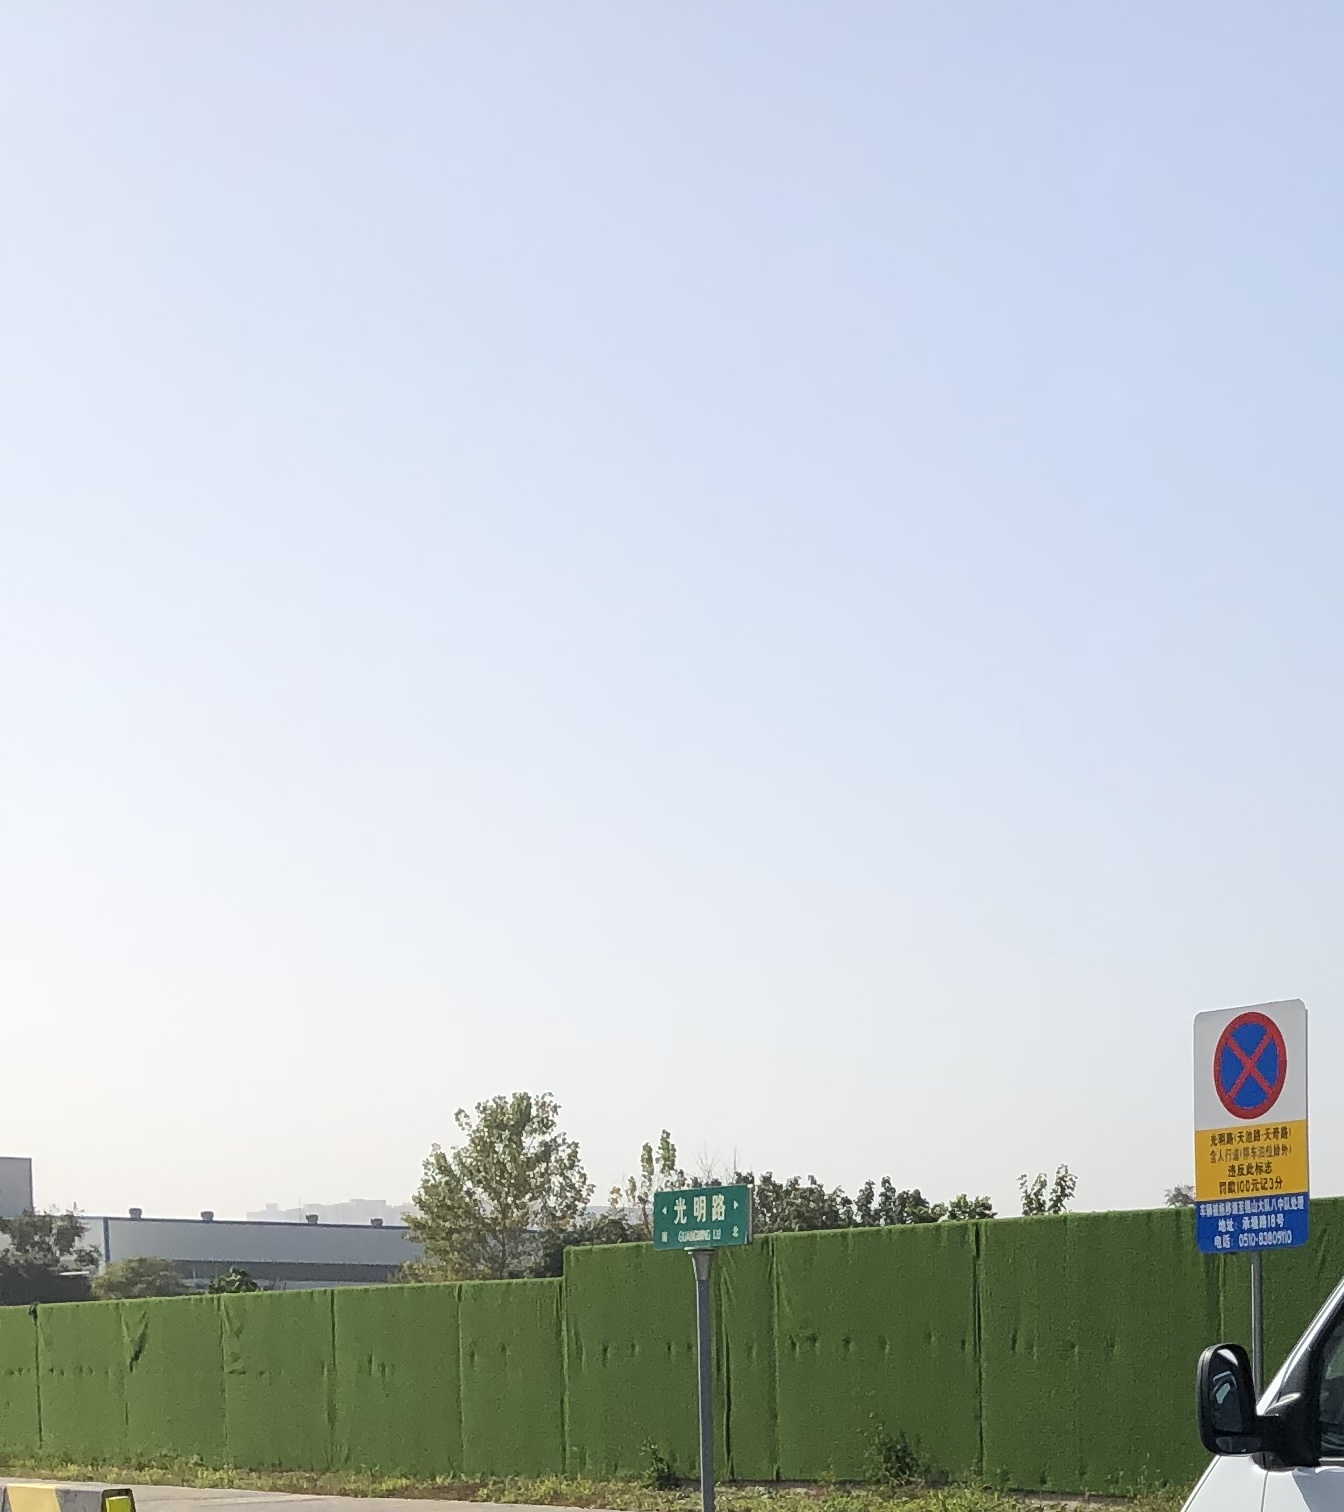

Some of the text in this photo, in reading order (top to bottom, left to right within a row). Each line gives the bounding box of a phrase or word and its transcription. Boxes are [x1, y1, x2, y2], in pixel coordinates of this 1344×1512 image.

[1228, 1160, 1273, 1178] 违反此标志
[1219, 1176, 1283, 1195] 罚款100元记3分
[673, 1193, 726, 1225] 光明路
